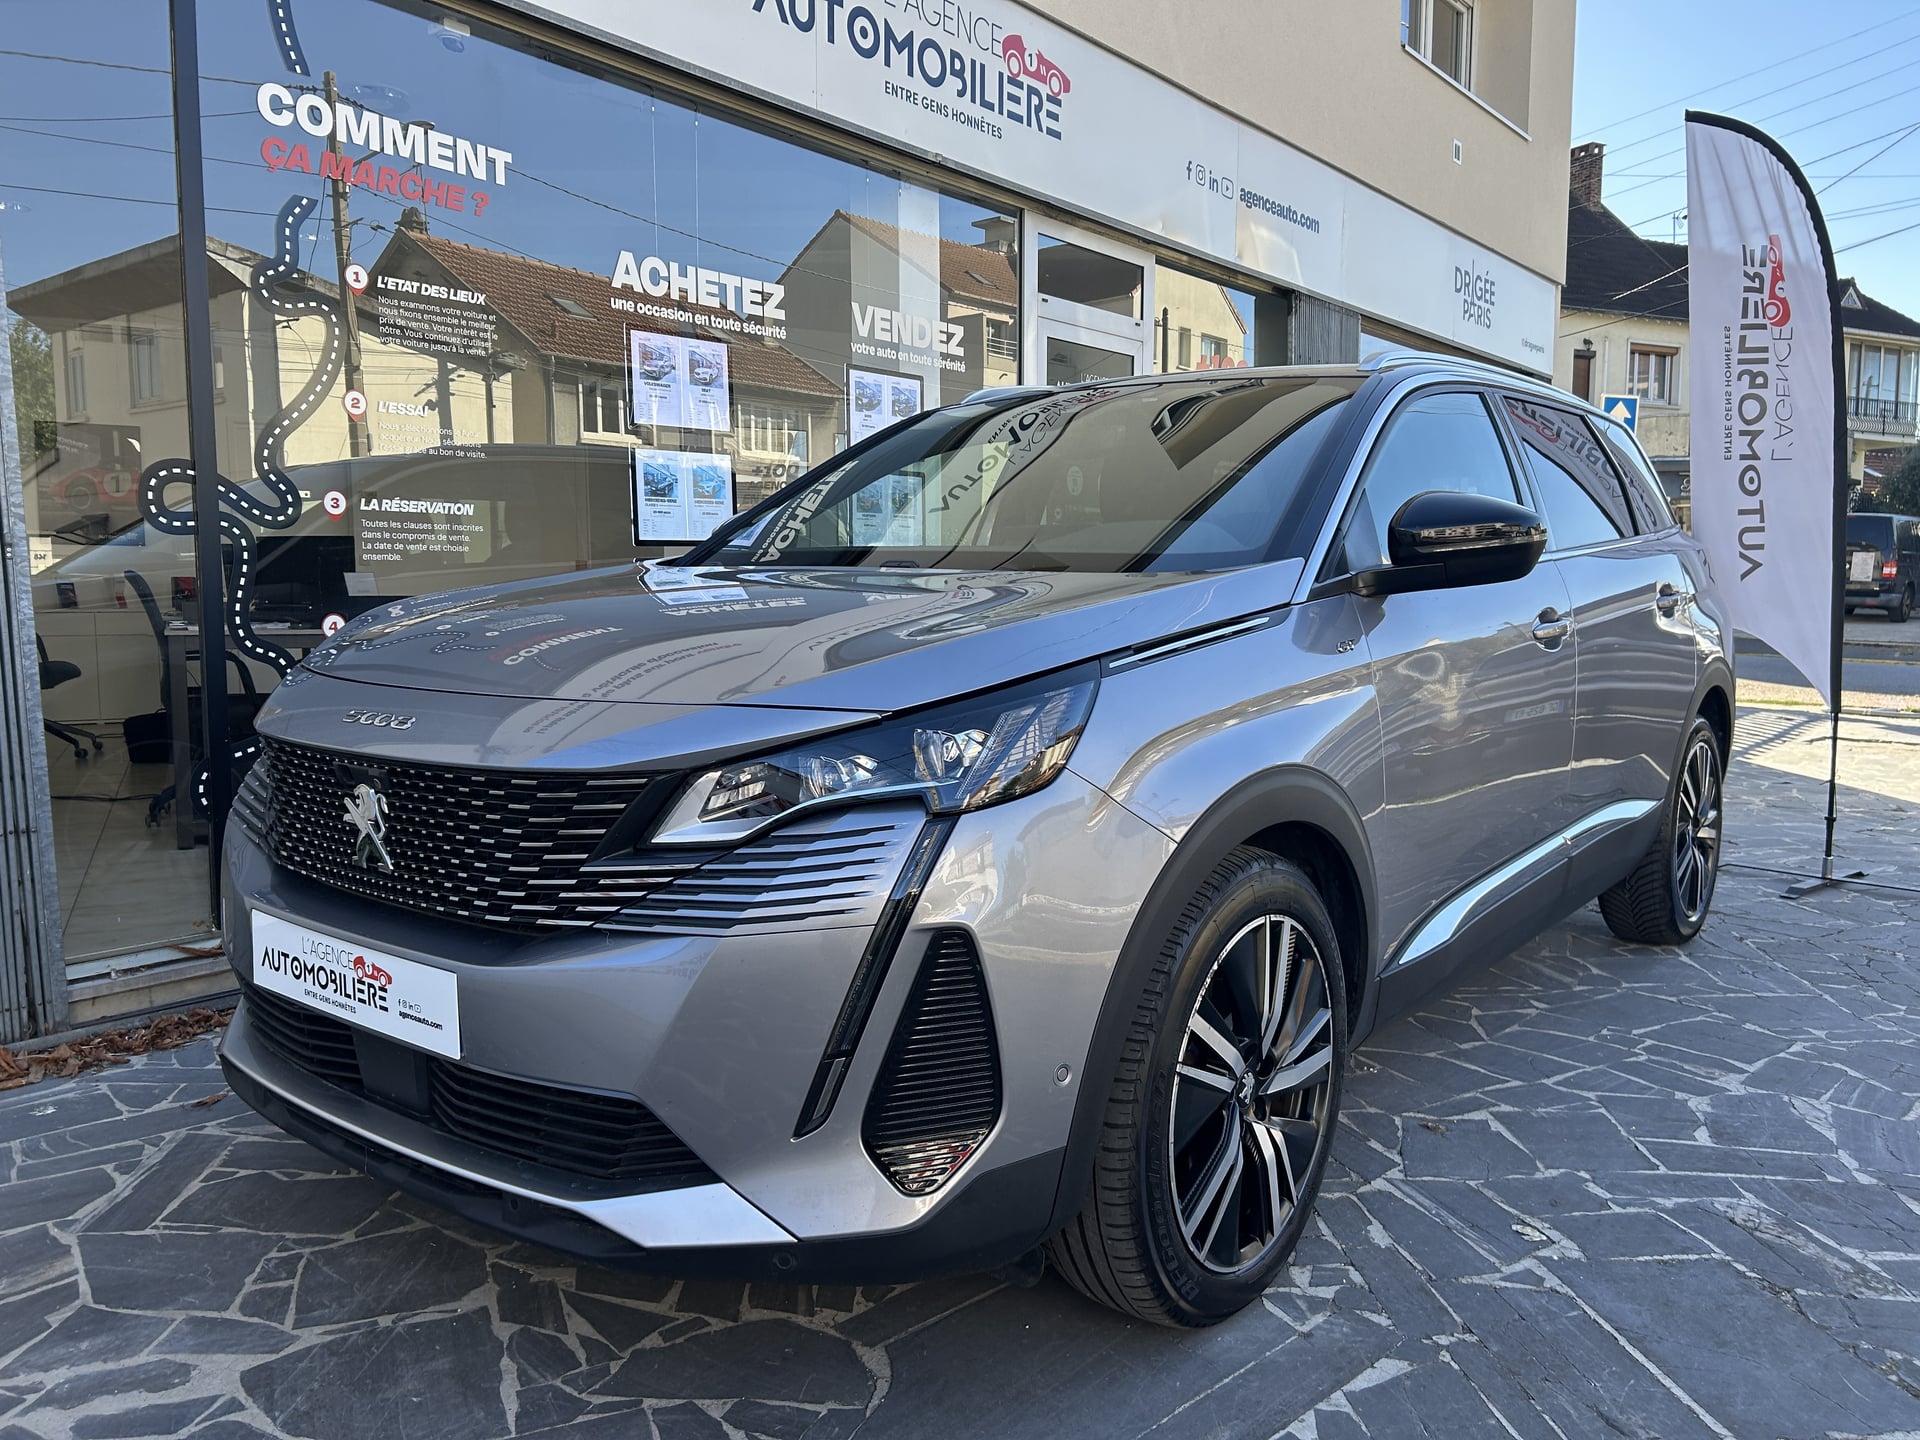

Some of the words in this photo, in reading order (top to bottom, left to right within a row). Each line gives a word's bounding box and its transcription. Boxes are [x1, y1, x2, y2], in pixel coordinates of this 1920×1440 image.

[884, 0, 1003, 59] AGENCE
[884, 81, 919, 107] ENTRE
[921, 95, 949, 118] GENS
[951, 107, 1003, 140] HONNÊTES
[256, 82, 513, 186] COMMENT
[260, 136, 312, 173] ÇA
[319, 150, 467, 212] MARCHE
[1239, 187, 1320, 234] agenceauto.com
[352, 271, 361, 283] 1
[611, 250, 786, 321] ACHETEZ
[1454, 260, 1496, 307] DRIGÉE
[376, 275, 420, 295] L'ETAT
[421, 283, 449, 299] DES
[449, 288, 487, 305] LIEUX
[378, 295, 398, 306] Nous
[400, 300, 440, 313] examinons
[441, 306, 460, 316] votre
[462, 310, 487, 320] voiture
[489, 314, 496, 322] et
[379, 306, 398, 316] nous
[400, 309, 422, 319] fixons
[423, 314, 459, 325] ensemble
[461, 318, 467, 326] le
[468, 320, 496, 330] meilleur
[610, 297, 634, 312] une
[636, 302, 693, 325] occasion
[694, 313, 708, 326] en
[710, 314, 741, 332] toute
[743, 320, 787, 340] sécurité
[1463, 297, 1491, 329] PARIS
[379, 316, 394, 327] prix
[396, 318, 406, 326] de
[407, 320, 430, 330] vente.
[432, 323, 452, 333] Votre
[454, 327, 476, 337] intérêt
[479, 331, 490, 339] est
[491, 332, 498, 340] le
[379, 326, 402, 335] nôtre.
[403, 329, 422, 339] Vous
[424, 333, 460, 344] continuez
[462, 337, 492, 348] d'utiliser
[851, 301, 965, 357] VENDEZ
[380, 336, 400, 345] votre
[402, 339, 429, 349] voiture
[430, 342, 457, 353] jusqu'à
[458, 345, 464, 354] la
[466, 348, 488, 357] vente.
[850, 342, 875, 356] votre
[876, 347, 897, 360] auto
[898, 351, 909, 361] en
[910, 352, 932, 366] toute
[933, 356, 966, 373] sérénité
[351, 397, 361, 409] 2
[377, 400, 429, 417] L'ESSAI
[440, 447, 453, 456] bon
[455, 448, 464, 457] de
[466, 449, 488, 459] visite.
[331, 497, 340, 509] 3
[360, 497, 379, 511] LA
[381, 497, 475, 516] RÉSERVATION
[361, 519, 388, 528] Toutes
[389, 520, 401, 529] les
[403, 521, 432, 530] clauses
[433, 523, 451, 531] sont
[452, 523, 484, 532] inscrites
[361, 530, 382, 539] dans
[383, 531, 390, 539] le
[391, 531, 436, 542] compromis
[437, 532, 447, 540] de
[448, 533, 471, 542] vente.
[362, 541, 372, 550] La
[373, 542, 392, 550] date
[393, 542, 404, 550] de
[405, 543, 427, 551] vente
[429, 543, 441, 552] est
[442, 543, 470, 552] choisie
[362, 553, 403, 561] ensemble.
[328, 621, 338, 632] 4
[301, 936, 354, 971] L'AGENCE
[261, 946, 389, 1013] AUTOMOBILIERE
[304, 989, 318, 1001] ENTRE
[318, 993, 331, 1005] GENS
[331, 997, 357, 1014] HONNÊTES
[398, 1010, 443, 1031] agenceauto.com
